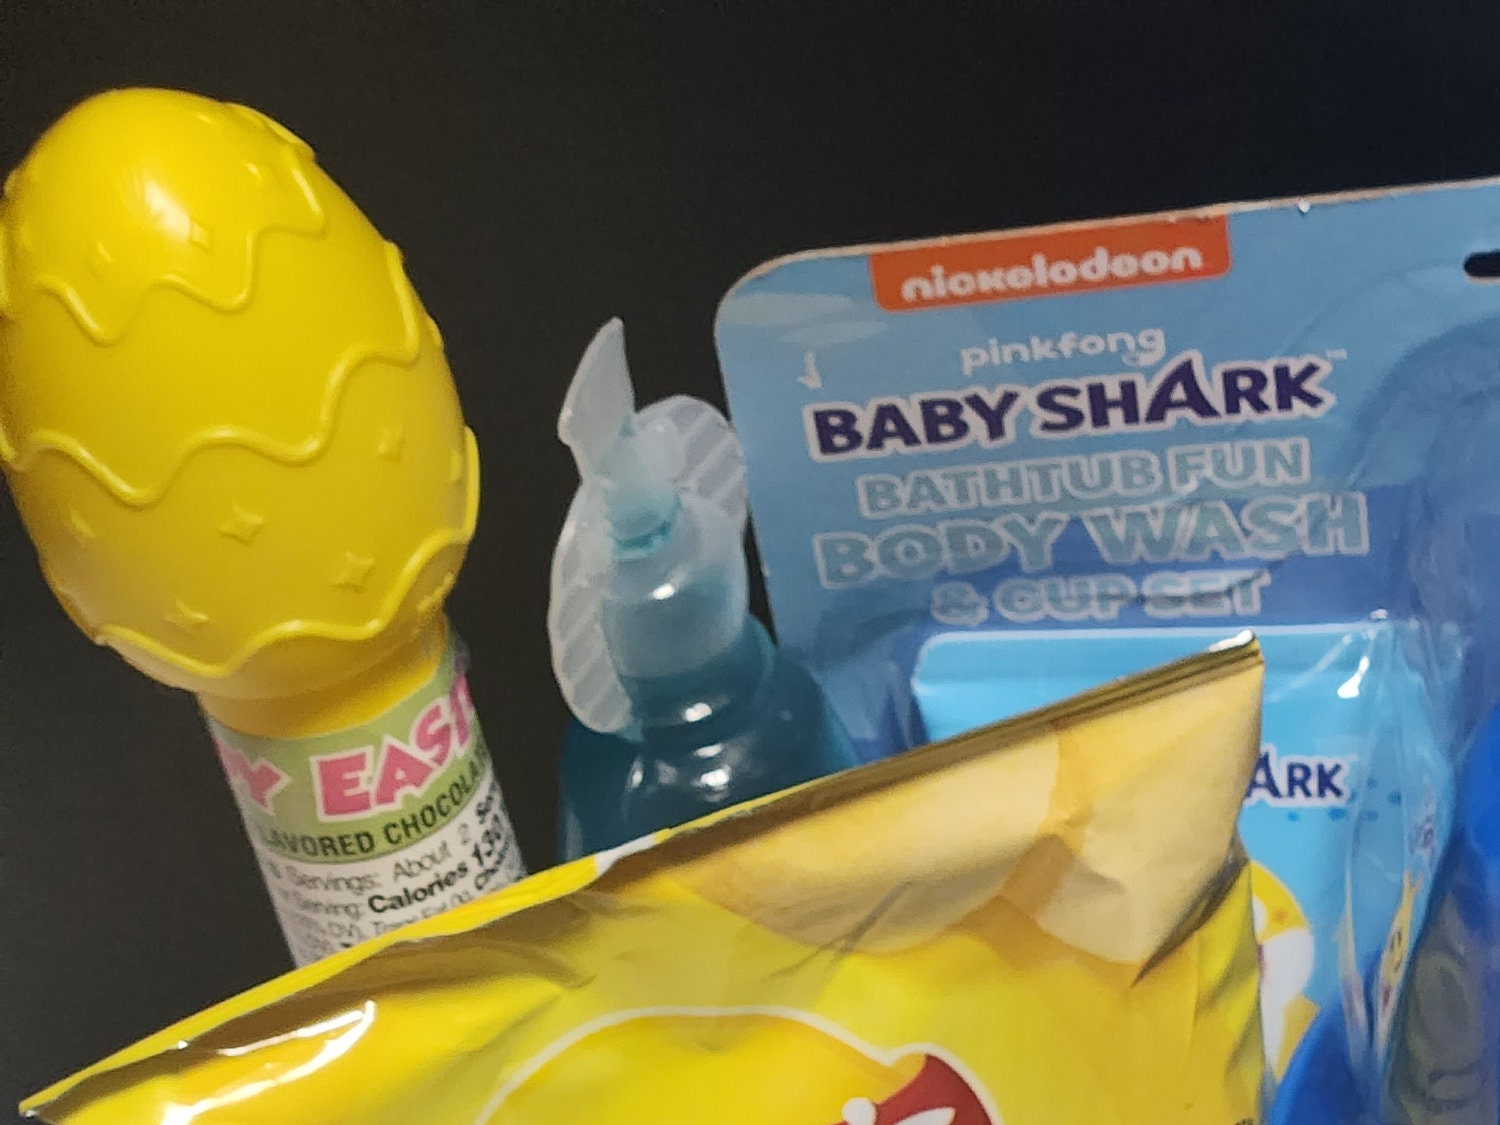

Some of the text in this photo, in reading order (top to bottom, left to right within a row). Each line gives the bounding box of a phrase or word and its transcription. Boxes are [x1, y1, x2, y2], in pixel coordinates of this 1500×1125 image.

[902, 245, 1204, 303] nickelodeon
[960, 326, 1166, 376] pinkfong
[808, 355, 1333, 460] BABY SHARK
[859, 438, 1311, 519] BATHTUB FUN
[812, 491, 1371, 590] BODY WASH
[931, 568, 1271, 627] & CUP SET
[1246, 748, 1346, 800] ARK
[367, 859, 469, 915] Calories
